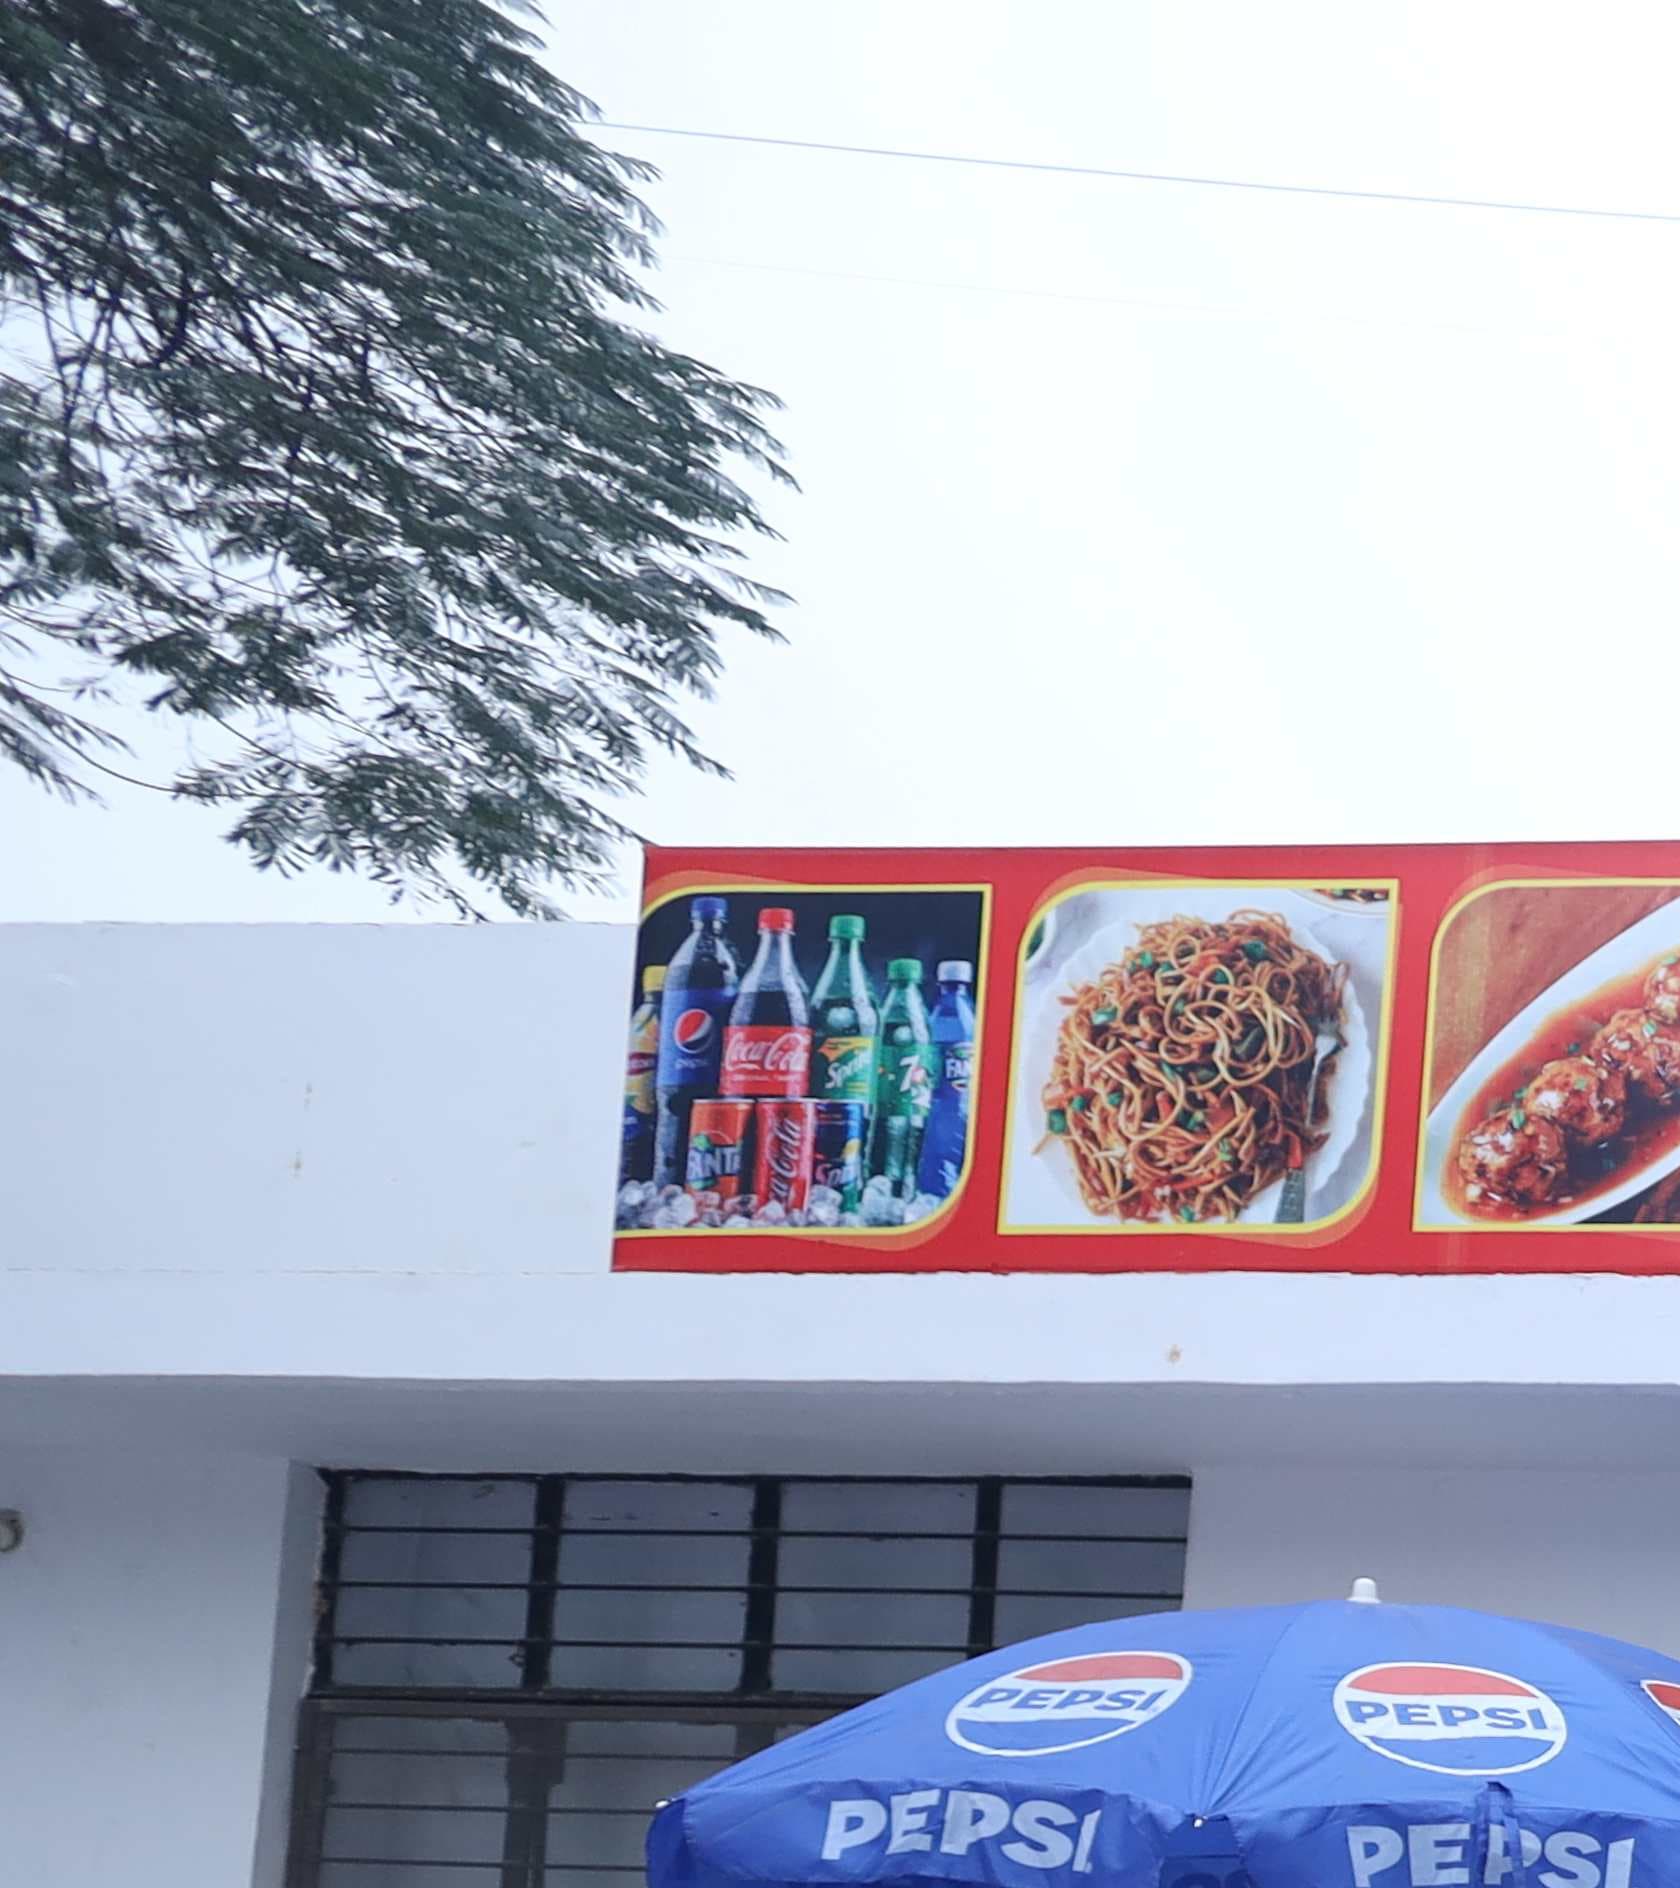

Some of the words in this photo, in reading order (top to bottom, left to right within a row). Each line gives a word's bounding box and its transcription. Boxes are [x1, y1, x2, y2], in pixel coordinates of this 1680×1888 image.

[969, 1688, 1160, 1713] PEPSI
[1344, 1700, 1550, 1731] PEPSI
[820, 1788, 1102, 1873] PEPSI
